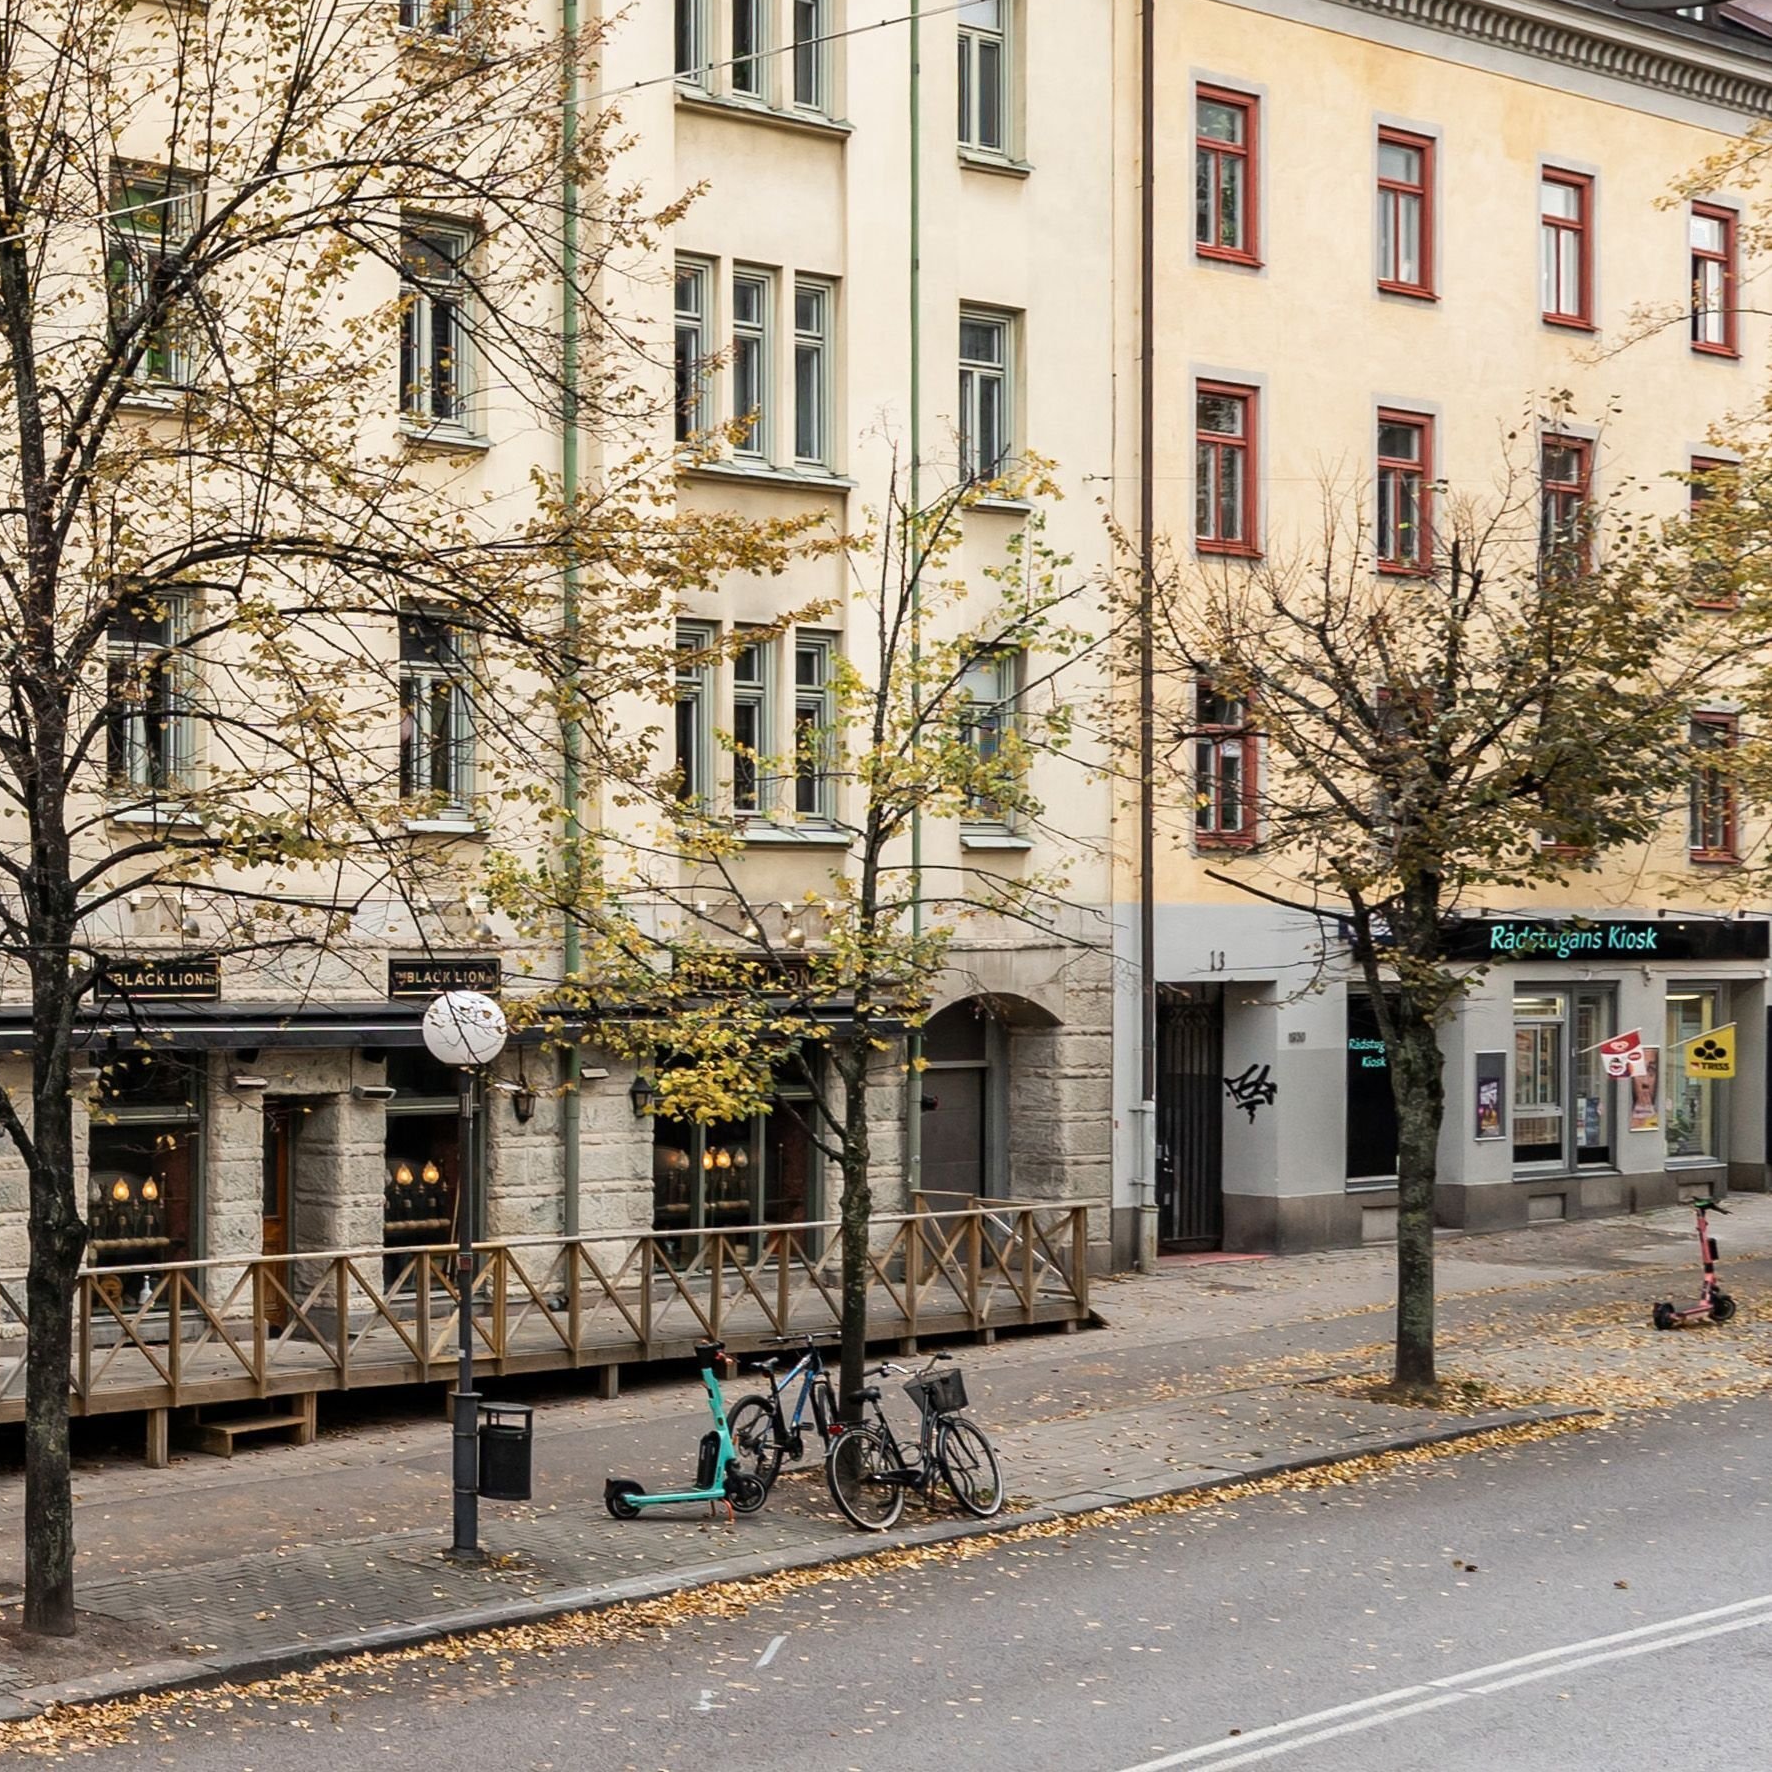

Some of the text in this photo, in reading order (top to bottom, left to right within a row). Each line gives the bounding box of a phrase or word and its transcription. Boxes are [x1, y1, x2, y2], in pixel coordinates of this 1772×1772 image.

[1608, 926, 1658, 949] Kiosk
[113, 973, 165, 986] BLACK
[170, 973, 204, 986] LION
[407, 971, 451, 983] BLACK
[455, 971, 486, 983] LION
[1348, 1039, 1386, 1053] Rådstug
[1361, 1057, 1387, 1067] Kiosk
[1701, 1062, 1730, 1071] TRISS
